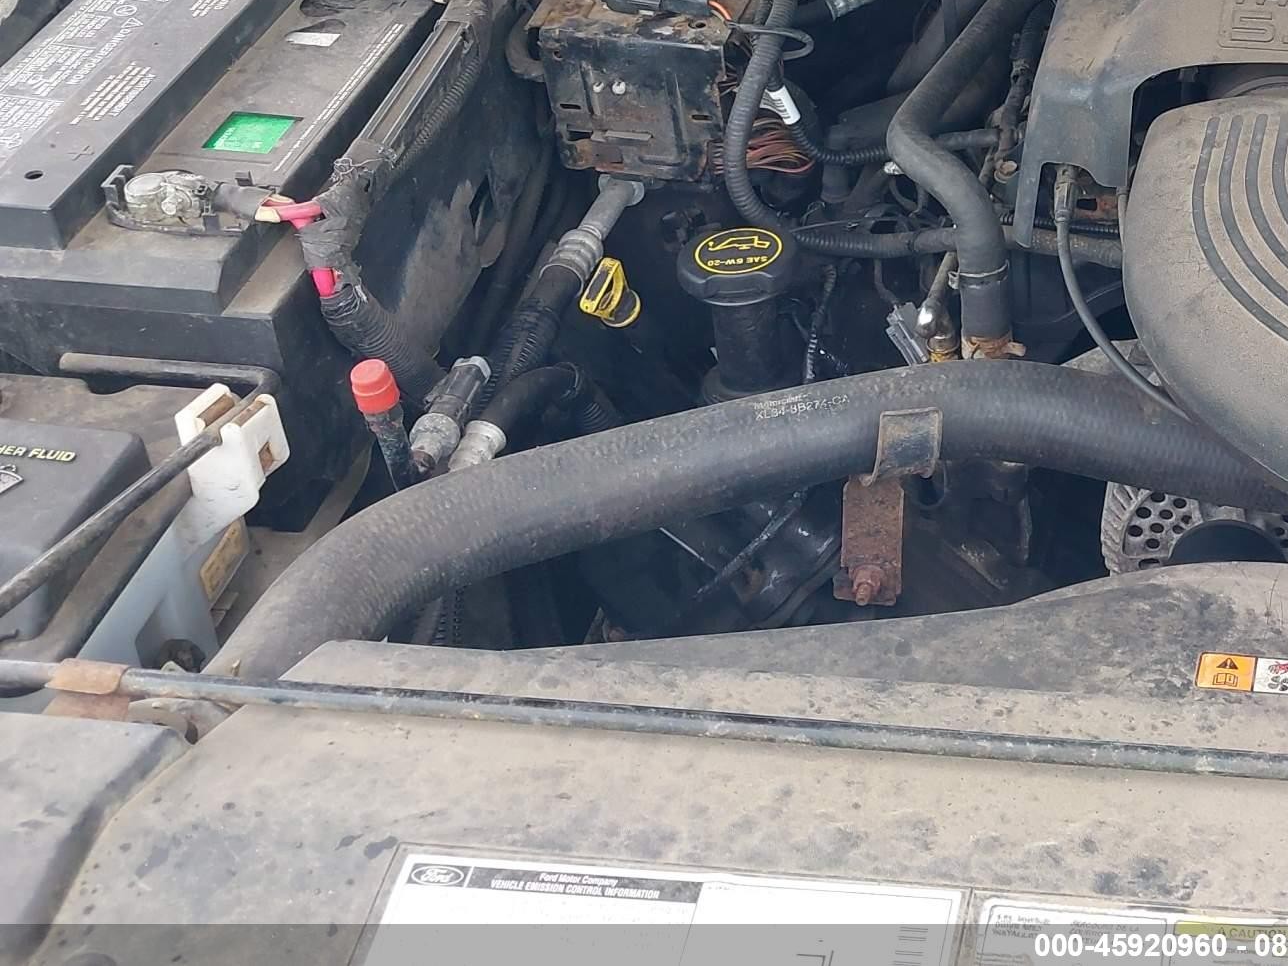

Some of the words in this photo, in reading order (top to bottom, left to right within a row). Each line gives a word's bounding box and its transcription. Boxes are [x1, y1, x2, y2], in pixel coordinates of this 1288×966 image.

[746, 255, 769, 265] SAE
[28, 447, 76, 462] FLUID
[539, 872, 559, 882] Ford
[559, 873, 582, 884] Motor
[582, 875, 619, 888] Company
[490, 879, 524, 890] VEHICLE
[525, 881, 564, 893] EMISSION
[566, 884, 603, 896] CONTROL
[604, 887, 660, 900] INFORMATION
